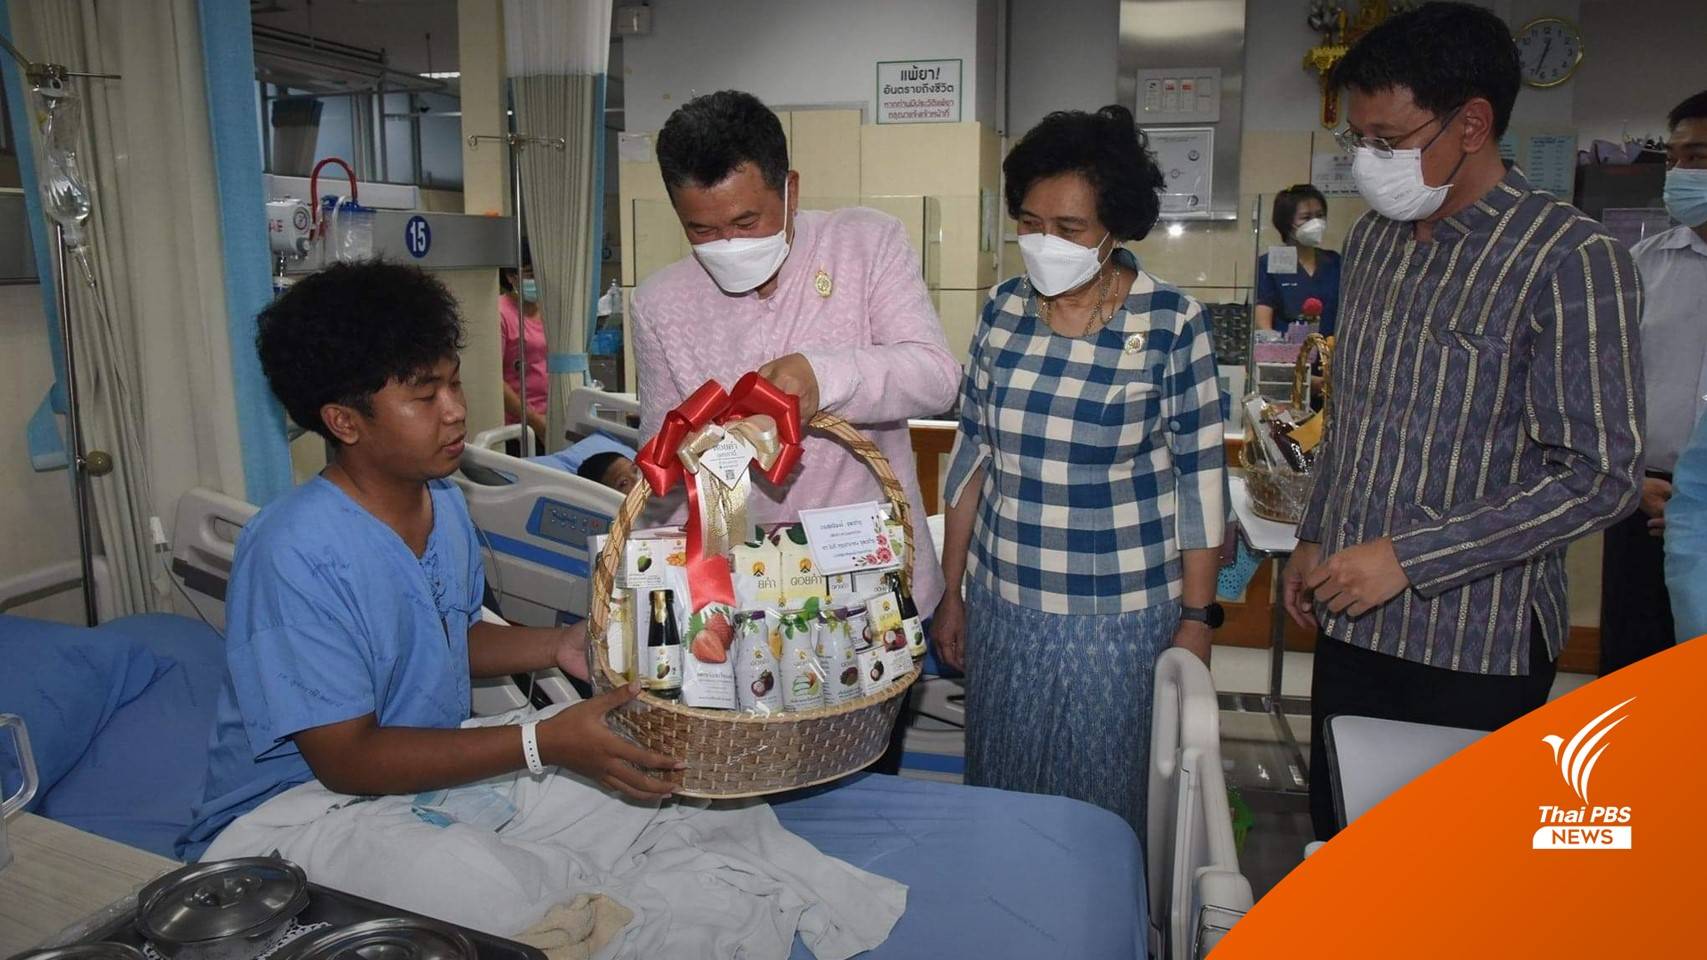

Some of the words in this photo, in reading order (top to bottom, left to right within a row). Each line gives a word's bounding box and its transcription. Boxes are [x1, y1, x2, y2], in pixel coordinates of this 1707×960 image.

[900, 65, 941, 81] แพ้ยา!
[883, 82, 954, 95] อันตรายถึงชีวิต
[410, 221, 427, 252] 15
[757, 576, 777, 589] ยคำ
[790, 573, 823, 586] ดอยคำ
